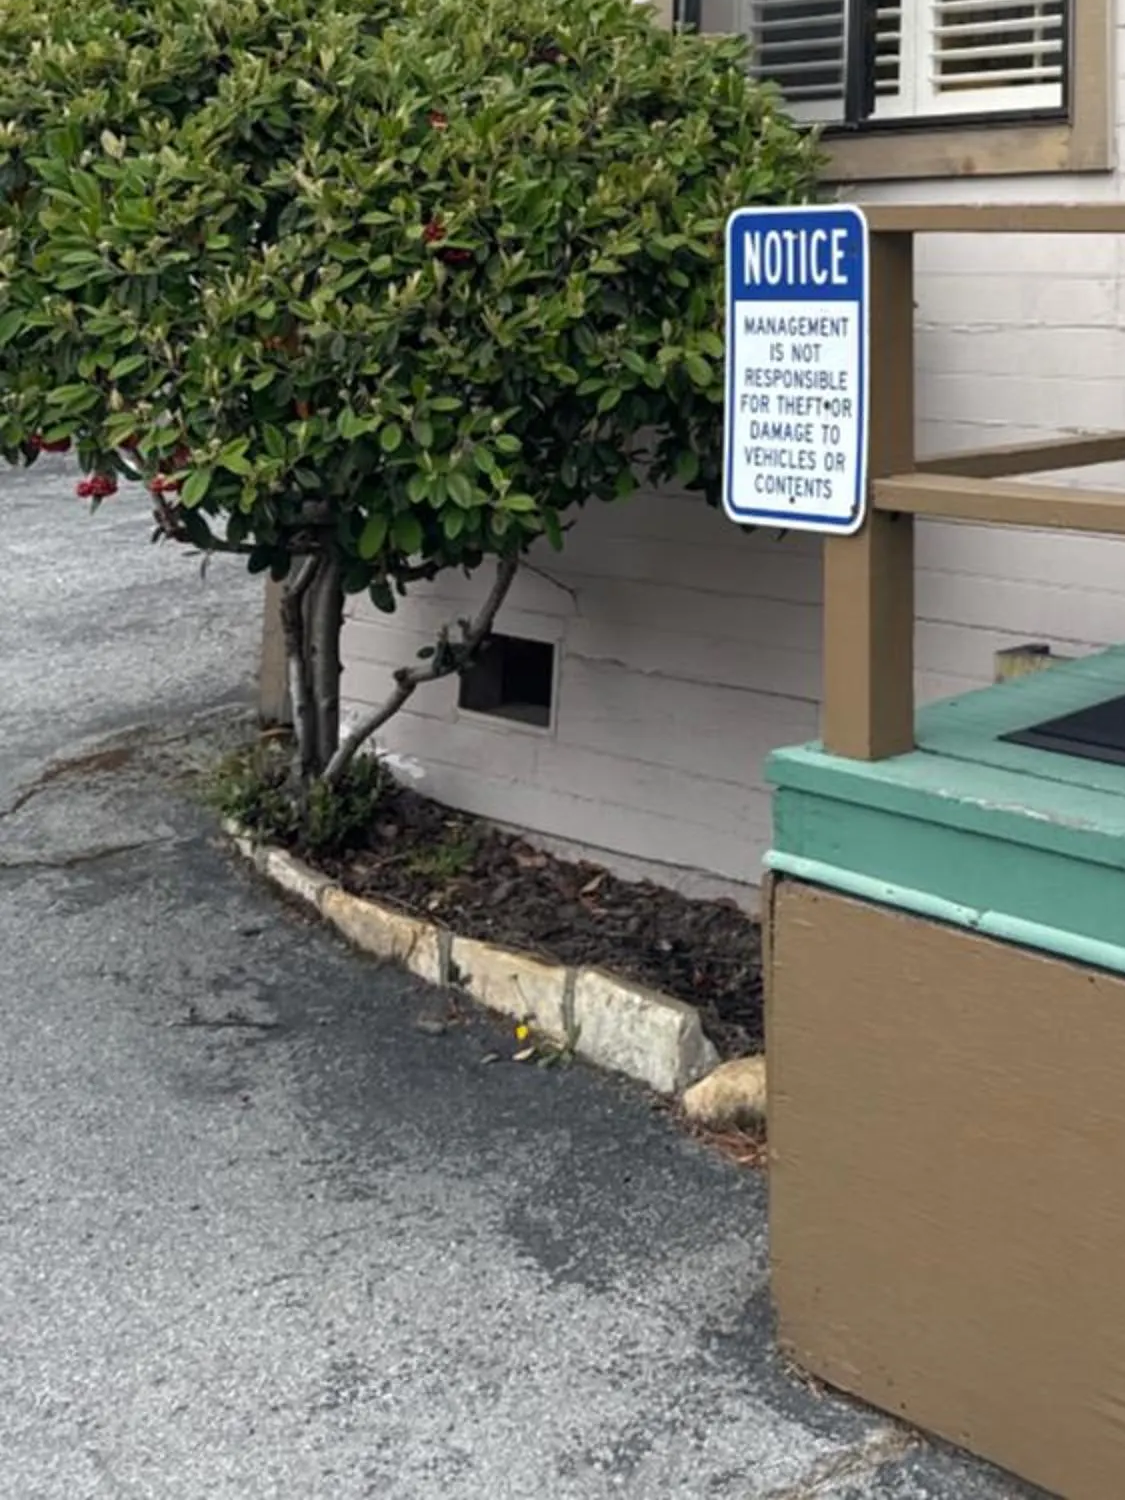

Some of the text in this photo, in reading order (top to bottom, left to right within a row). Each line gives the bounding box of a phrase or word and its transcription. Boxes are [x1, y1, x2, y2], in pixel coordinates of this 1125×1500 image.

[743, 228, 848, 285] NOTICE
[743, 315, 849, 338] MANAGEMENT
[769, 343, 822, 363] IS NOT
[744, 368, 848, 391] RESPONSIBLE
[740, 393, 852, 418] FOR THEFT OR
[749, 420, 841, 445] DAMAGE TO
[744, 446, 846, 473] VEHICLES OR
[754, 473, 832, 499] CONTENTS
